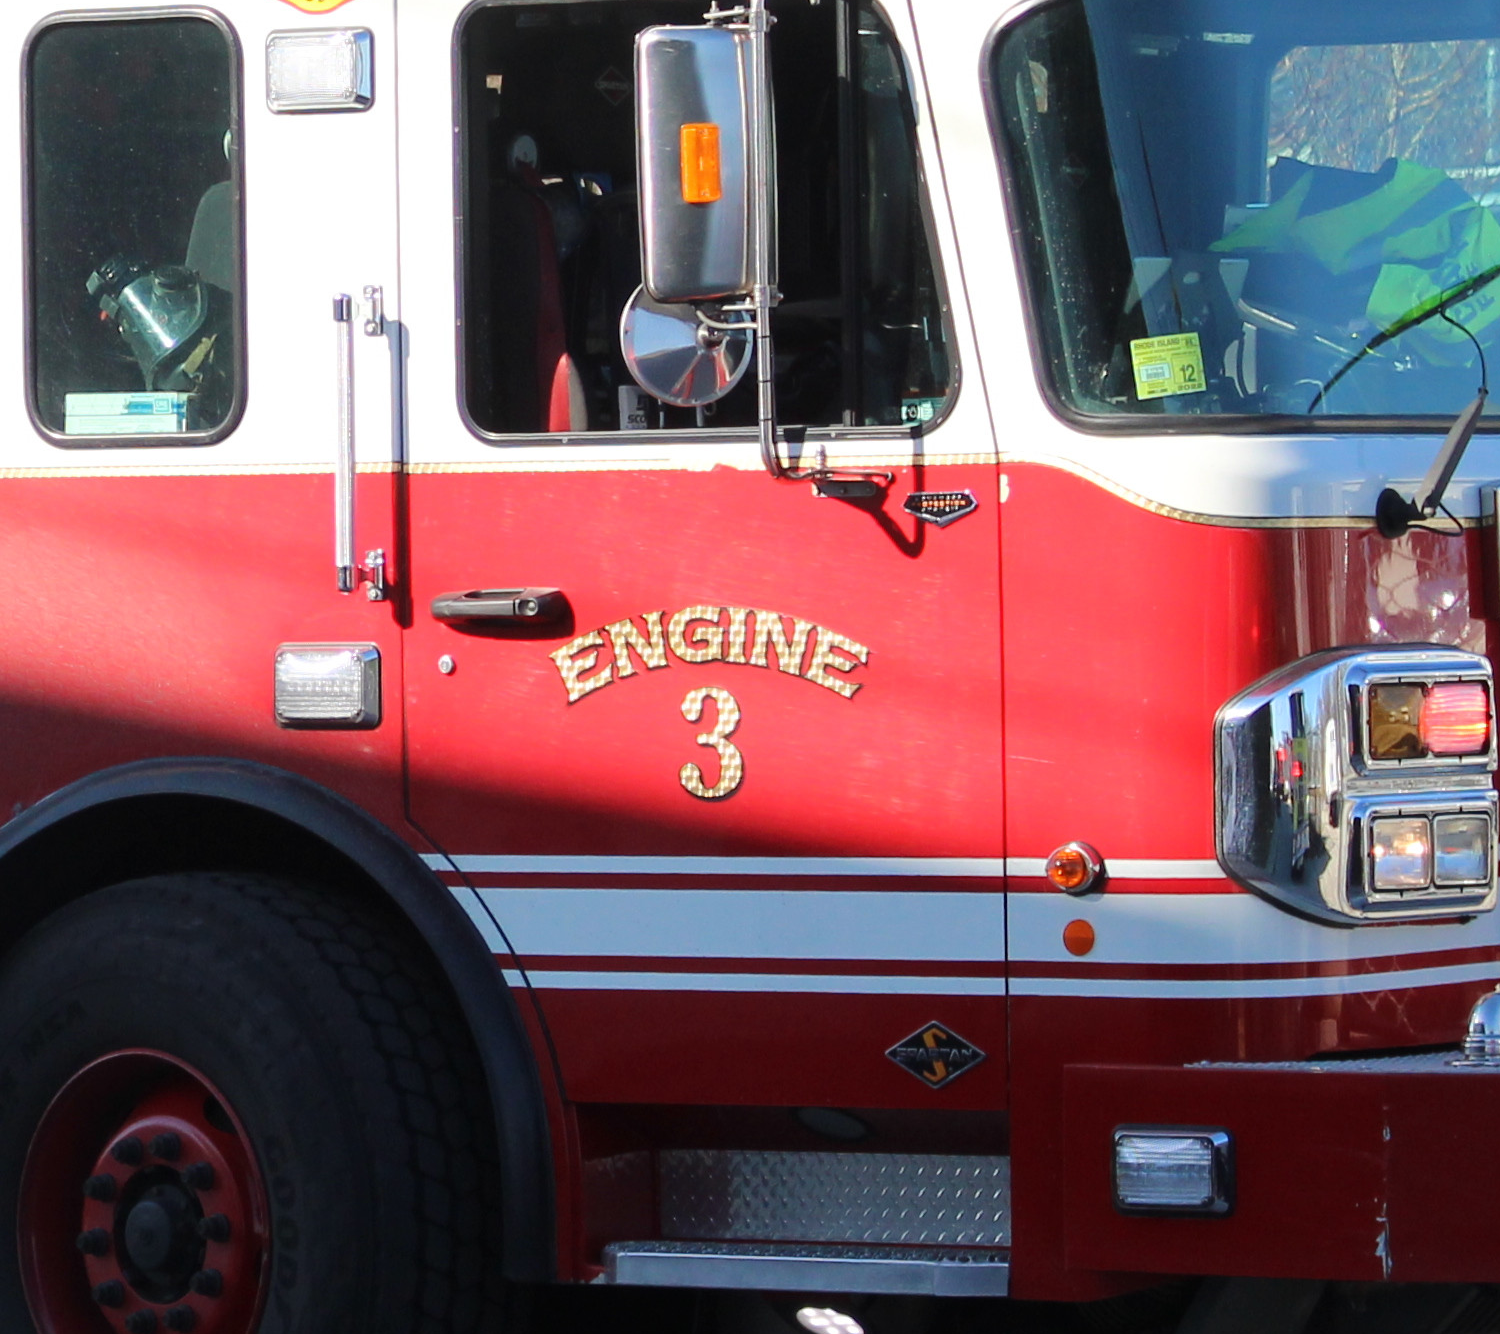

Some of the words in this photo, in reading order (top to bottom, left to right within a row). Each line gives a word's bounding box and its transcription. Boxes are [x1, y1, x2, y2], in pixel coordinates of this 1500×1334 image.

[1180, 364, 1197, 382] 12
[550, 604, 870, 704] ENGINE
[678, 687, 745, 802] 3
